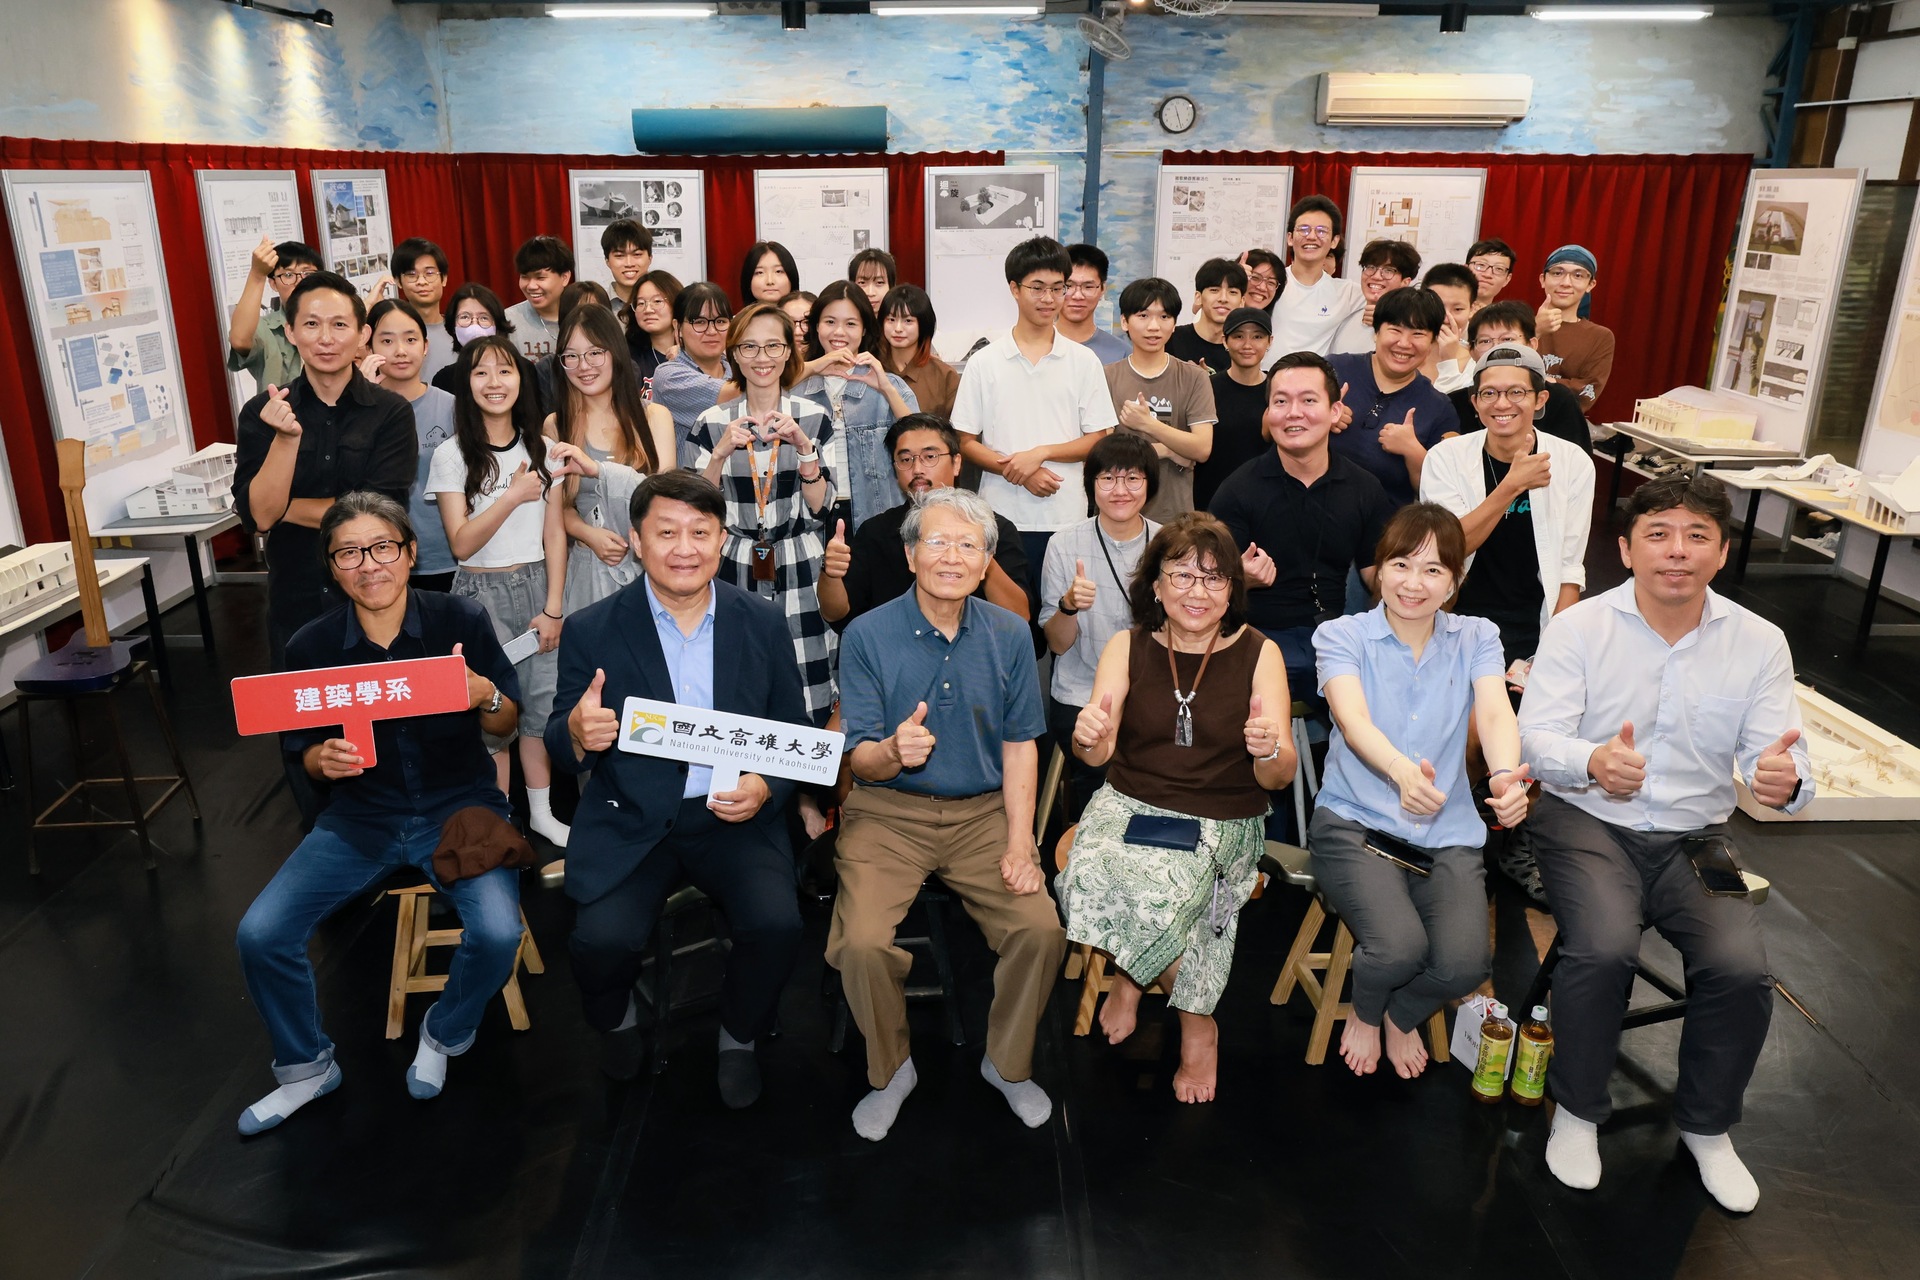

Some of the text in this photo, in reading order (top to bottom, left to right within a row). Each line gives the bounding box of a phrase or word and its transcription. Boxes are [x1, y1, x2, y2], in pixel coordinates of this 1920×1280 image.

[294, 677, 411, 712] 建築學系
[669, 738, 829, 774] National University of Kaohsiung
[672, 720, 833, 760] 國立高雄大學
